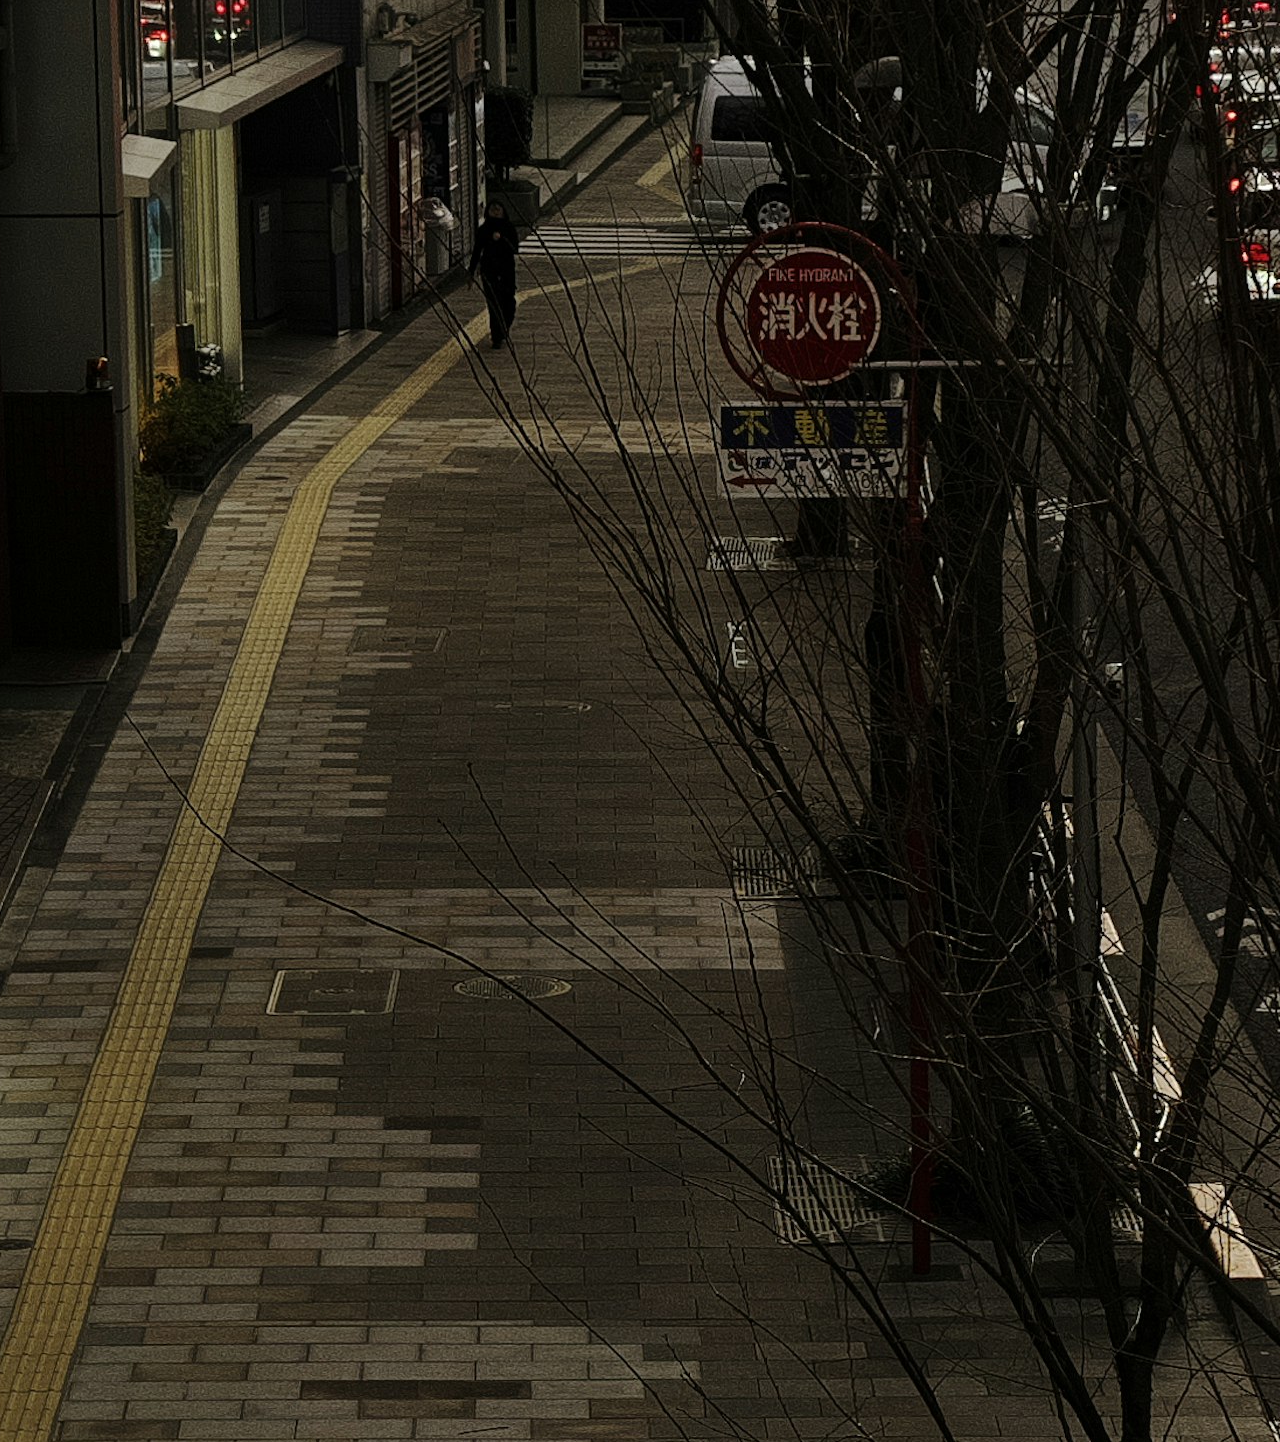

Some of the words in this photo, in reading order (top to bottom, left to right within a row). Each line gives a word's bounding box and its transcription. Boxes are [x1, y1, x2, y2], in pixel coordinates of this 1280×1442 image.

[799, 267, 854, 282] HYDRANT
[759, 291, 868, 341] 消火栓
[732, 408, 889, 447] 不動産
